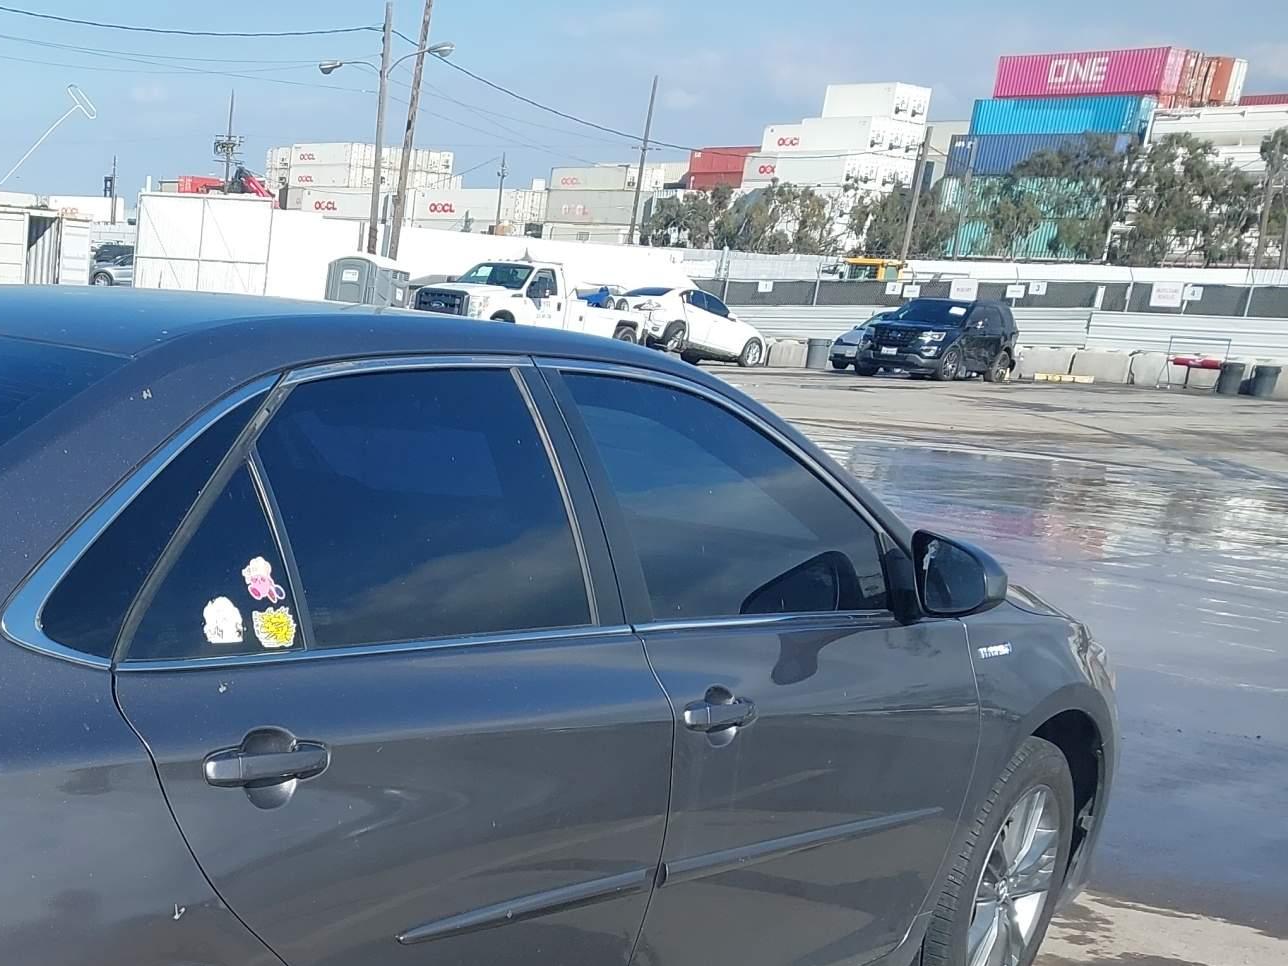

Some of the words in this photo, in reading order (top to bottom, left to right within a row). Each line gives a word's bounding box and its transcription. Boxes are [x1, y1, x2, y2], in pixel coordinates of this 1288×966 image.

[1048, 56, 1108, 83] ONE
[314, 200, 337, 211] OOCL
[429, 202, 455, 213] OOCL
